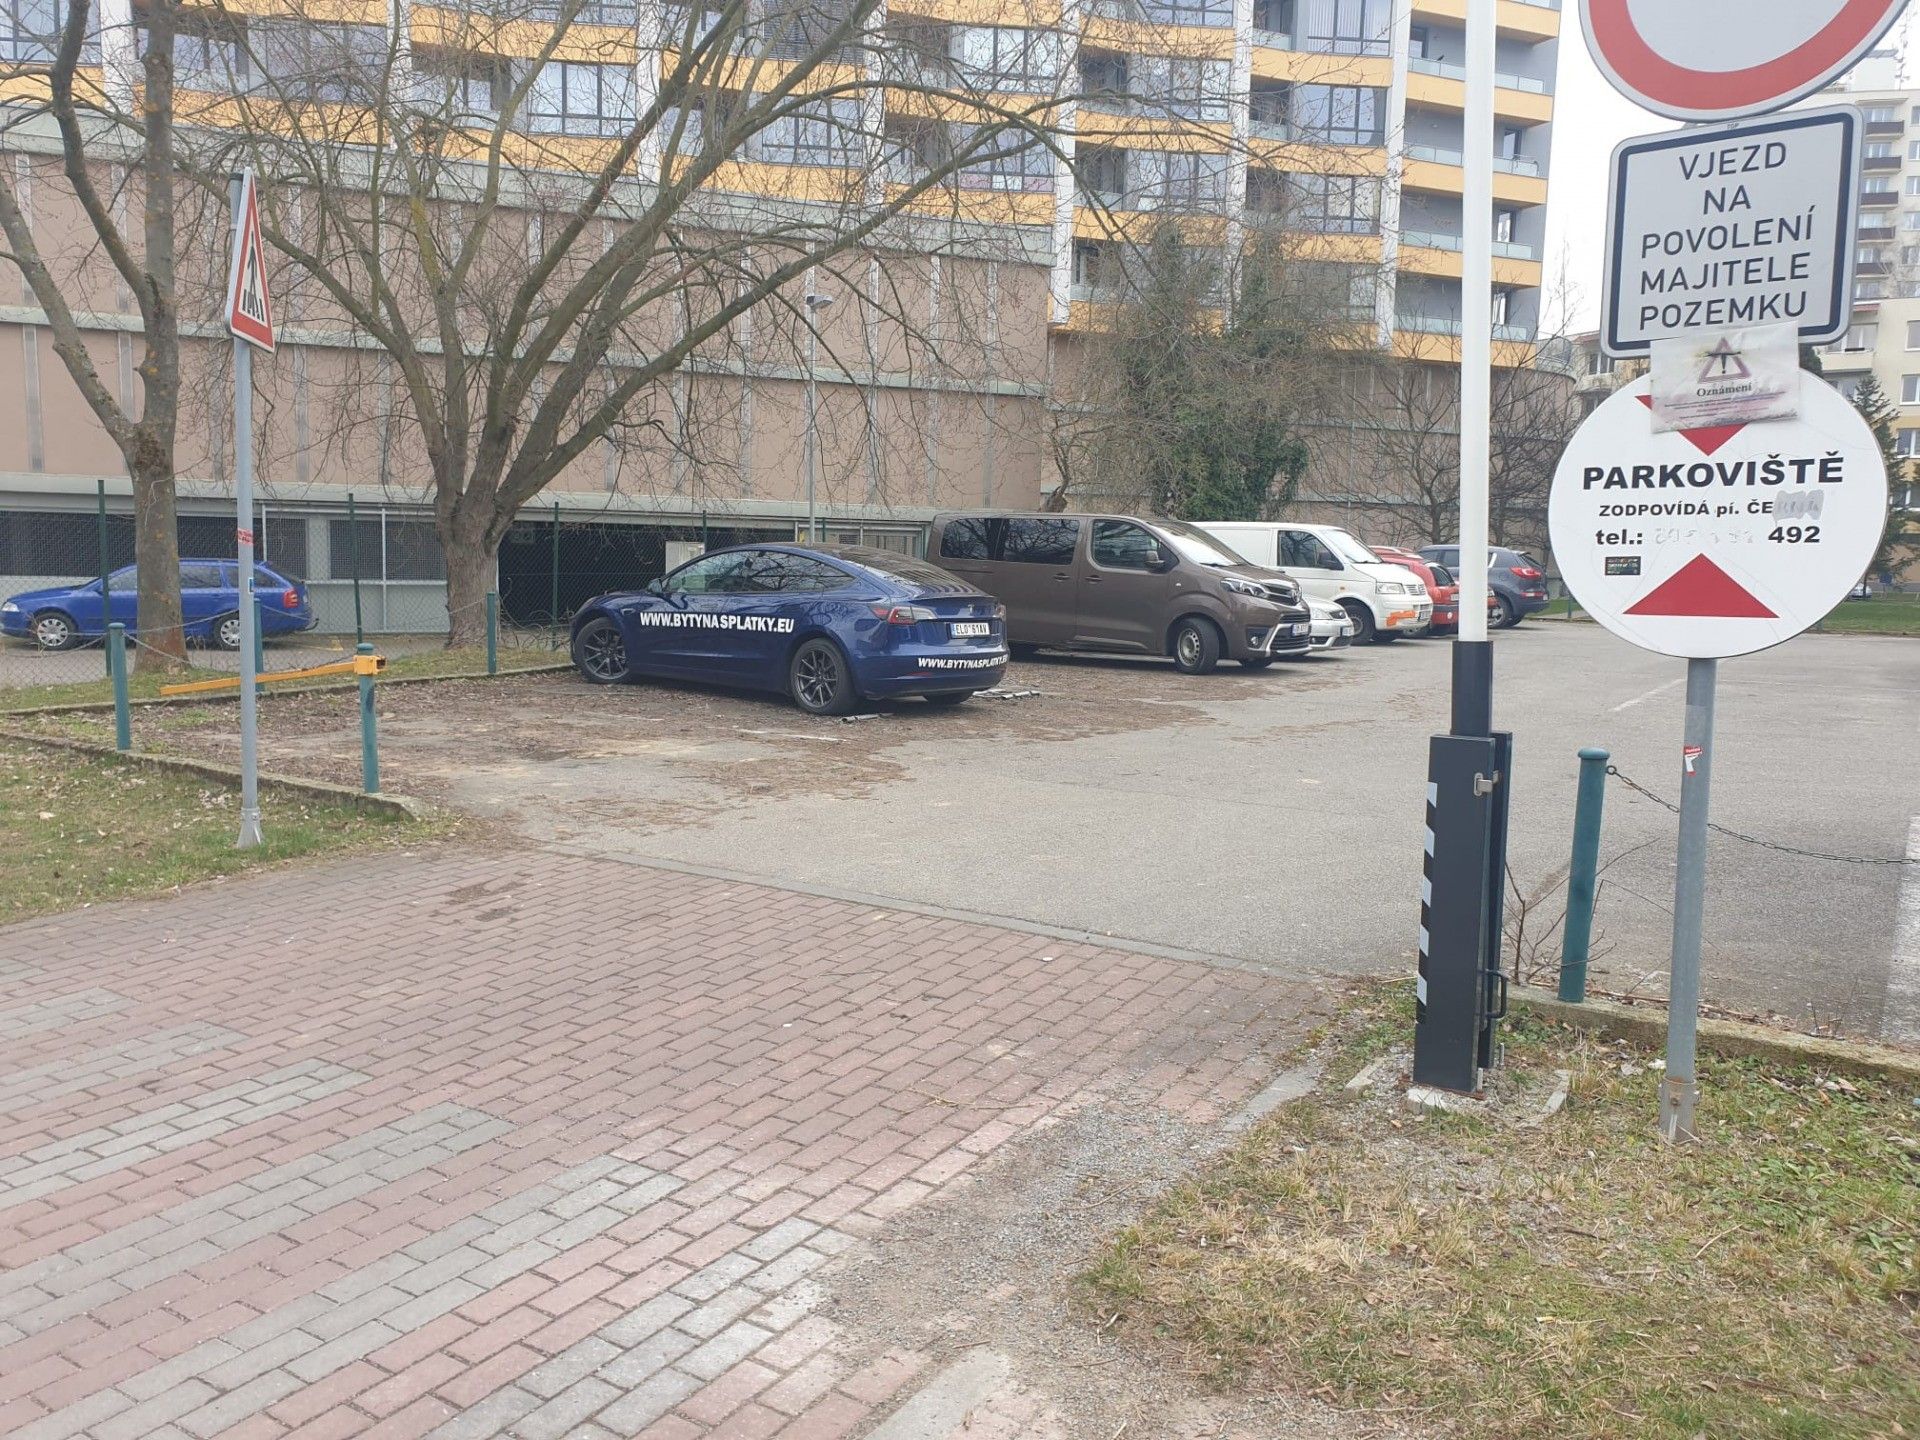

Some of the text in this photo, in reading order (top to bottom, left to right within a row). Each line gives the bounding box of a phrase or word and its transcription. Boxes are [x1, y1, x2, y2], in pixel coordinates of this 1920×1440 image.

[1679, 142, 1787, 181] VJEZD
[1703, 185, 1751, 215] NA
[1641, 205, 1816, 259] POVOLENÍ
[1640, 252, 1811, 295] MAJITELE
[1639, 291, 1807, 331] POZEMKU
[1696, 382, 1752, 397] Oznámení
[1583, 451, 1845, 490] PARKOVIŠTĚ
[1599, 500, 1710, 517] ZODPOVÍDÁ
[1716, 502, 1740, 518] pí.
[1595, 529, 1643, 545] tel.:
[1768, 525, 1821, 544] 492
[640, 612, 795, 633] WWW.BYTYNASPLATKY.EU
